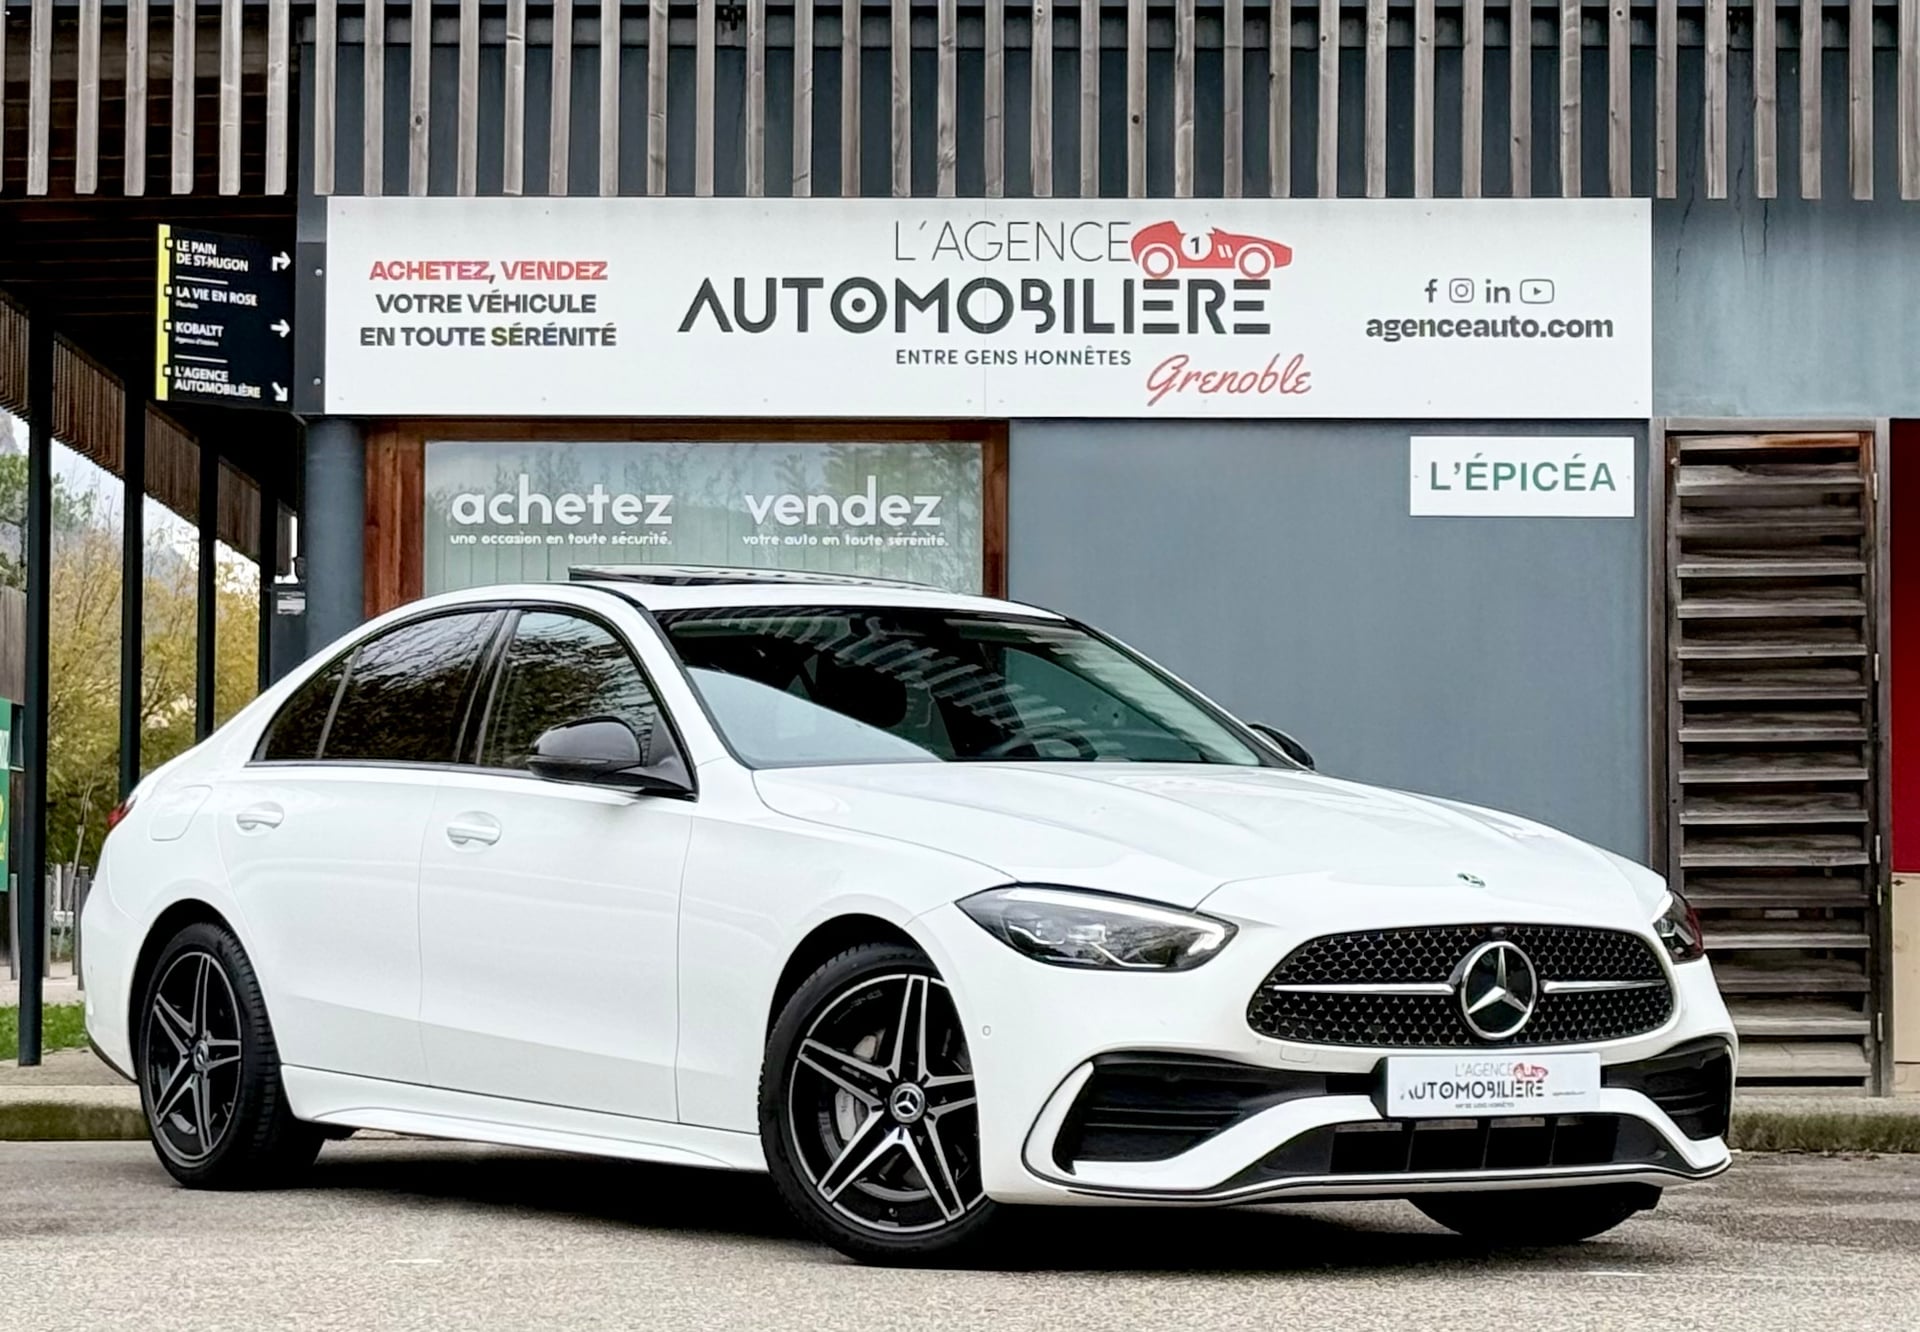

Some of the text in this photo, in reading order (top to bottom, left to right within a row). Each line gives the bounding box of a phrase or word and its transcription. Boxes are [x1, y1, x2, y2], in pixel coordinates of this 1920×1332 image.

[176, 239, 217, 255] LE PAIN
[895, 220, 1132, 262] L'AGENCE
[176, 253, 249, 272] DE ST-HUGON
[369, 260, 608, 284] ACHETEZ, VENDEZ
[176, 286, 258, 306] LA VIE EN ROSE
[375, 289, 597, 314] VOTRE VÉHICULE
[175, 320, 224, 338] KOBALTT
[359, 322, 617, 347] EN TOUTE SÉRÉNITÉ
[1366, 315, 1614, 342] agenceauto.com
[896, 345, 1132, 366] ENTRE GENS HONNÊTES
[174, 365, 229, 382] L'AGENCE
[1146, 353, 1312, 407] Grenoble
[1430, 452, 1617, 491] L'ÉPICÉA
[451, 473, 674, 525] achetez
[744, 475, 943, 526] vendez
[450, 530, 673, 545] une occasion en toute sécurité.
[742, 531, 949, 547] votre auto en toute sérénité.
